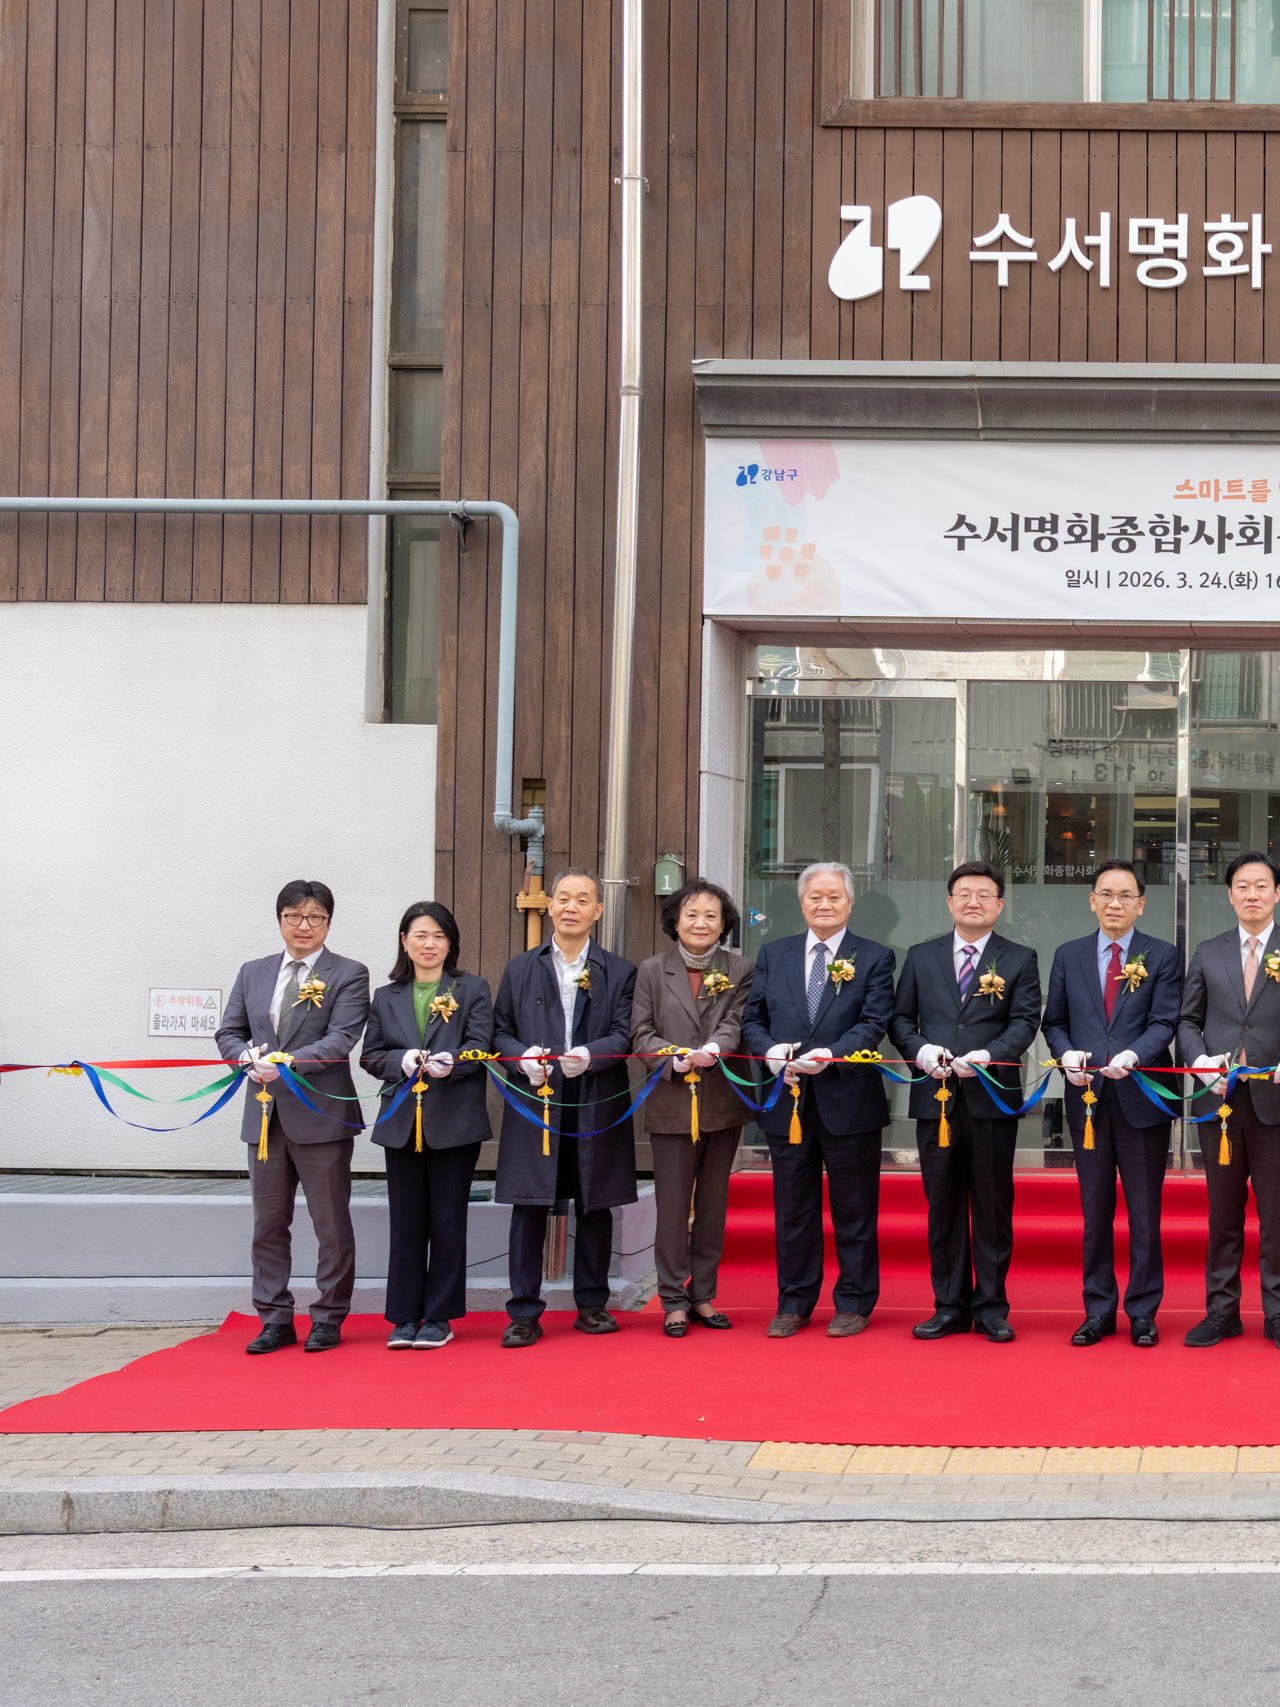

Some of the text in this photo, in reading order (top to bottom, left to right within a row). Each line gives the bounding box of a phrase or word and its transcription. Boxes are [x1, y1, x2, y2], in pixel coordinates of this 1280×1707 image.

[761, 467, 799, 483] 강남구
[1173, 478, 1271, 504] 스마트를
[1065, 569, 1099, 590] 일시
[1118, 571, 1169, 589] 2026.
[1176, 571, 1193, 589] 3.
[1199, 571, 1259, 591] 24.(화)
[1217, 752, 1252, 771] 누리는
[1253, 751, 1275, 775] 행복
[1012, 865, 1100, 878] 수서명화종합사회
[661, 874, 672, 890] 1
[168, 995, 203, 1007] 추락위험
[153, 1013, 216, 1032] 올라가지 마세요
